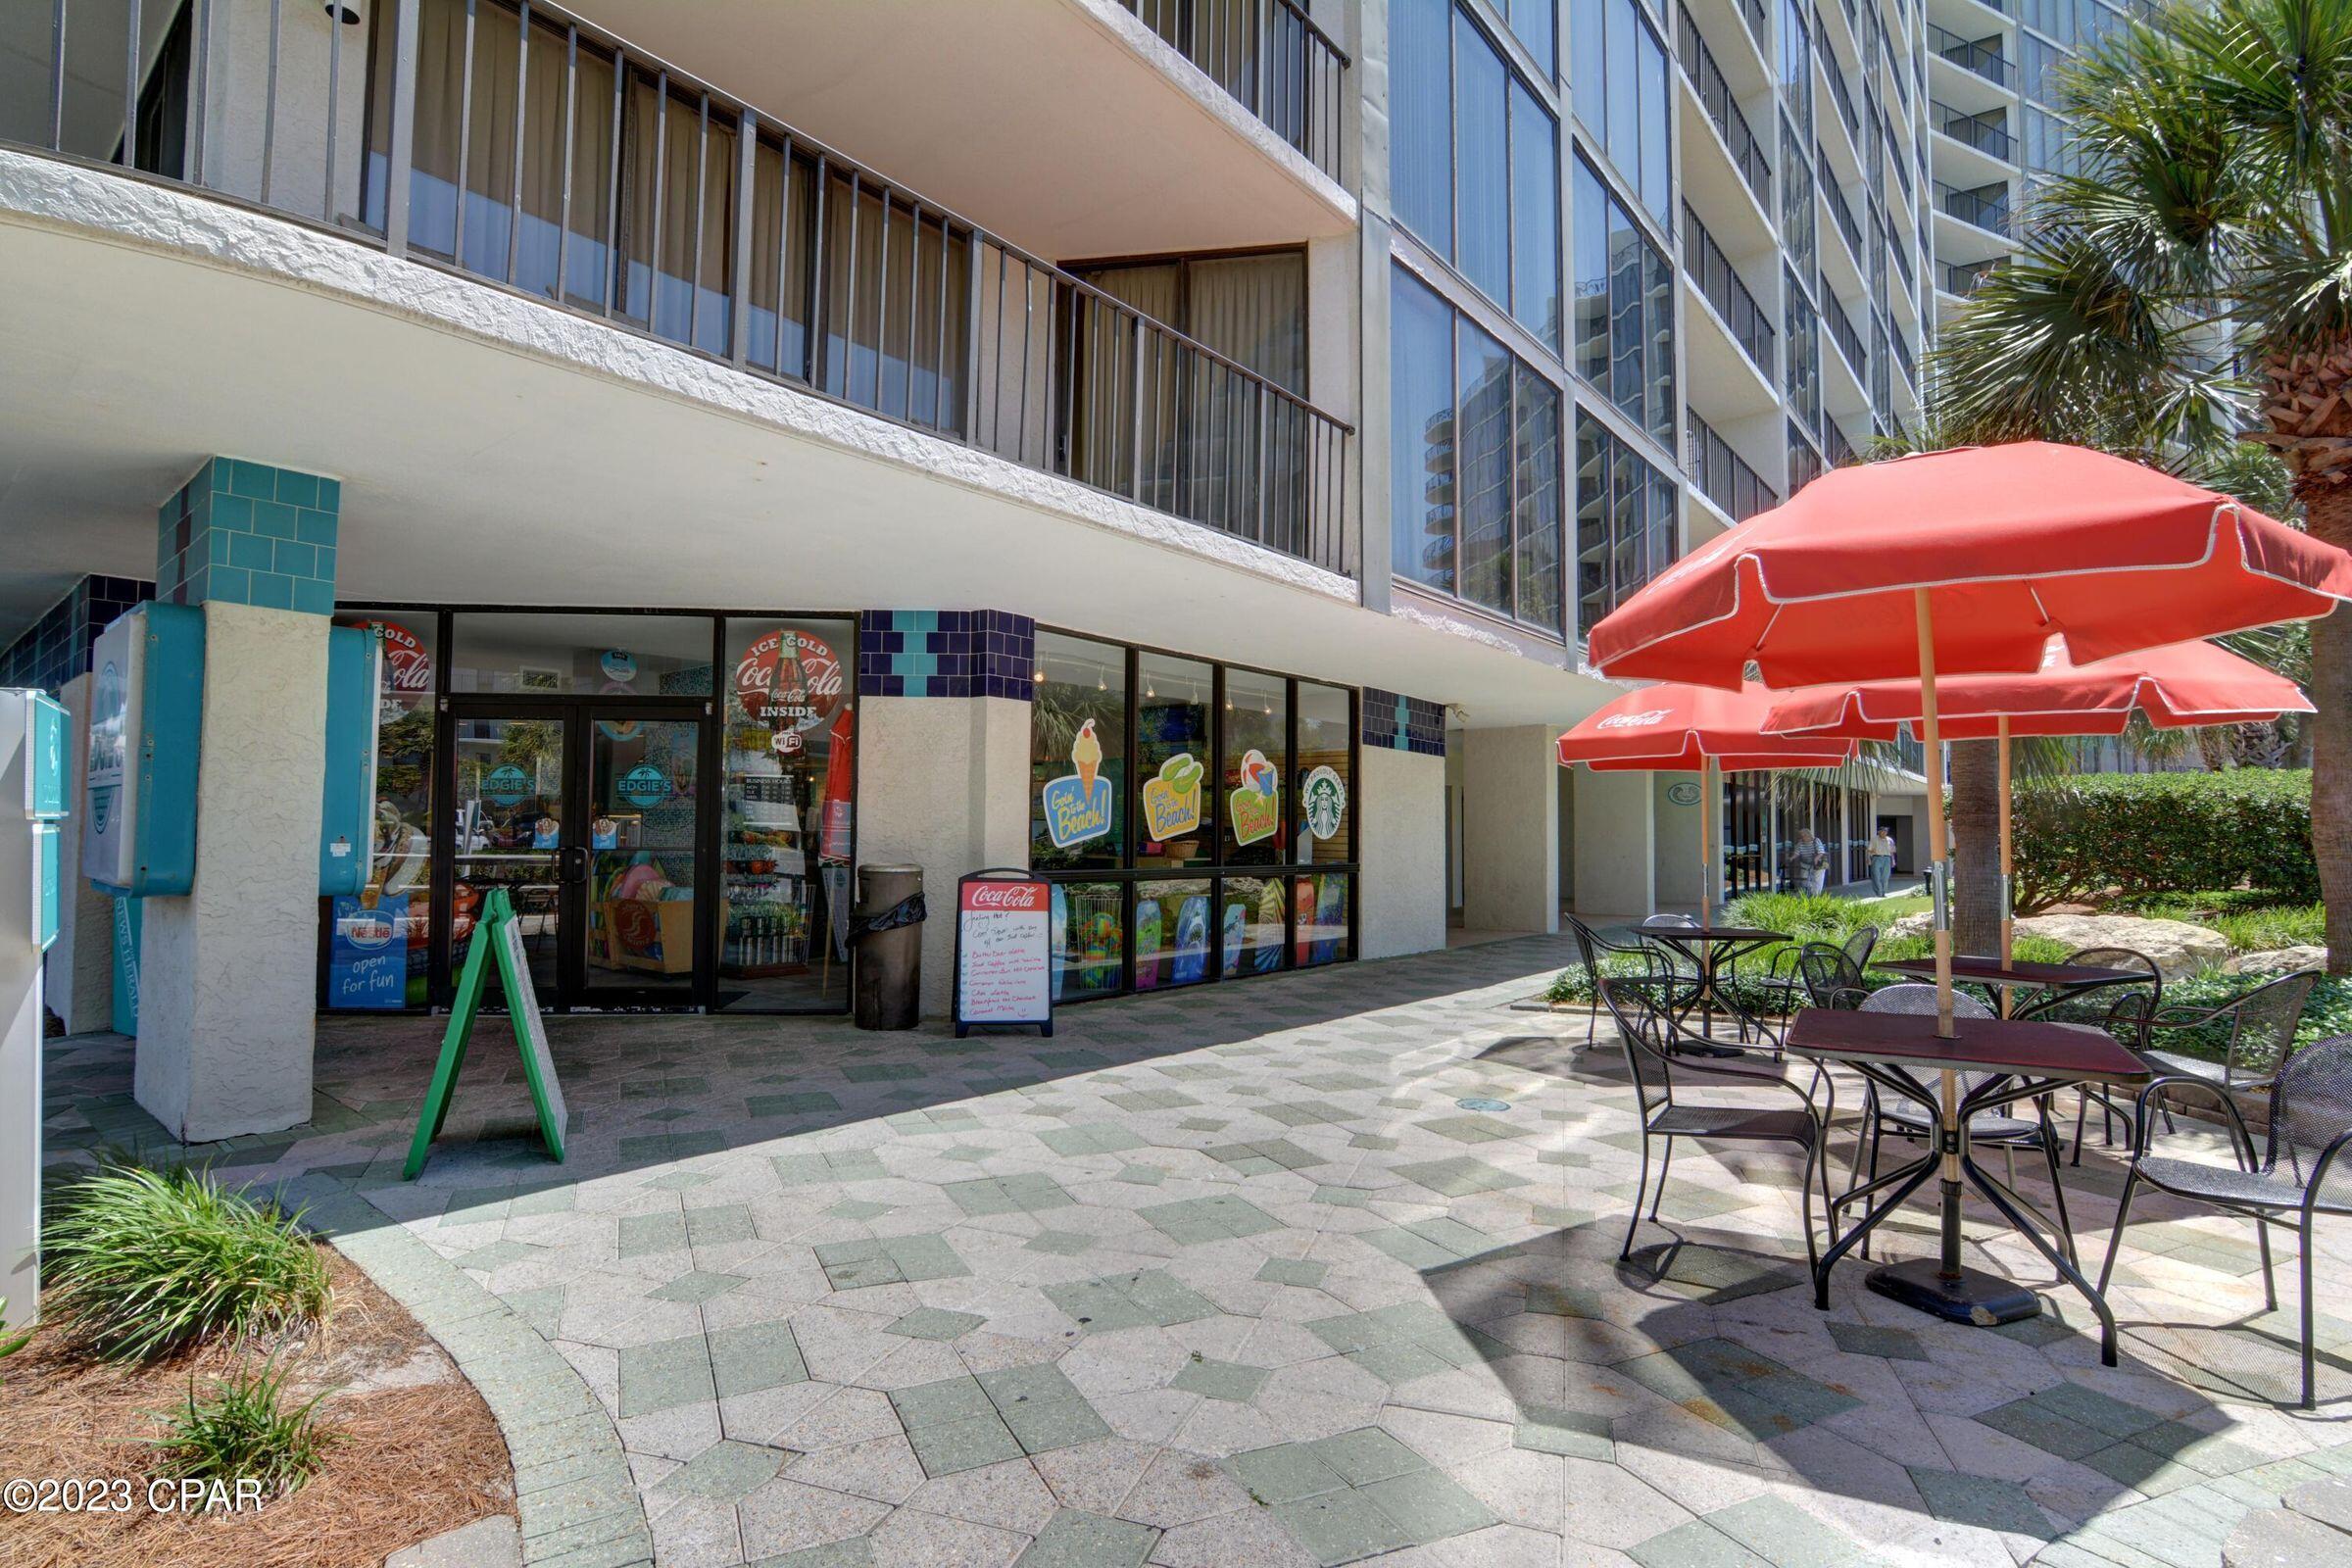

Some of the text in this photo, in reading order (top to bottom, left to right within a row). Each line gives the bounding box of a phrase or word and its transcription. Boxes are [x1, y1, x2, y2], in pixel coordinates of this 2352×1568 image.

[373, 626, 416, 649] COLD
[751, 636, 828, 657] ICE COLD
[760, 706, 817, 717] INSIDE
[481, 779, 535, 791] EDGIE'S
[618, 780, 672, 792] EDGIE'S
[1058, 789, 1107, 841] Beach!
[1156, 788, 1196, 833] Beach!
[971, 885, 1039, 907] Coca-Cola
[116, 897, 128, 946] NEWS
[353, 956, 386, 974] open
[342, 969, 394, 995] for fun
